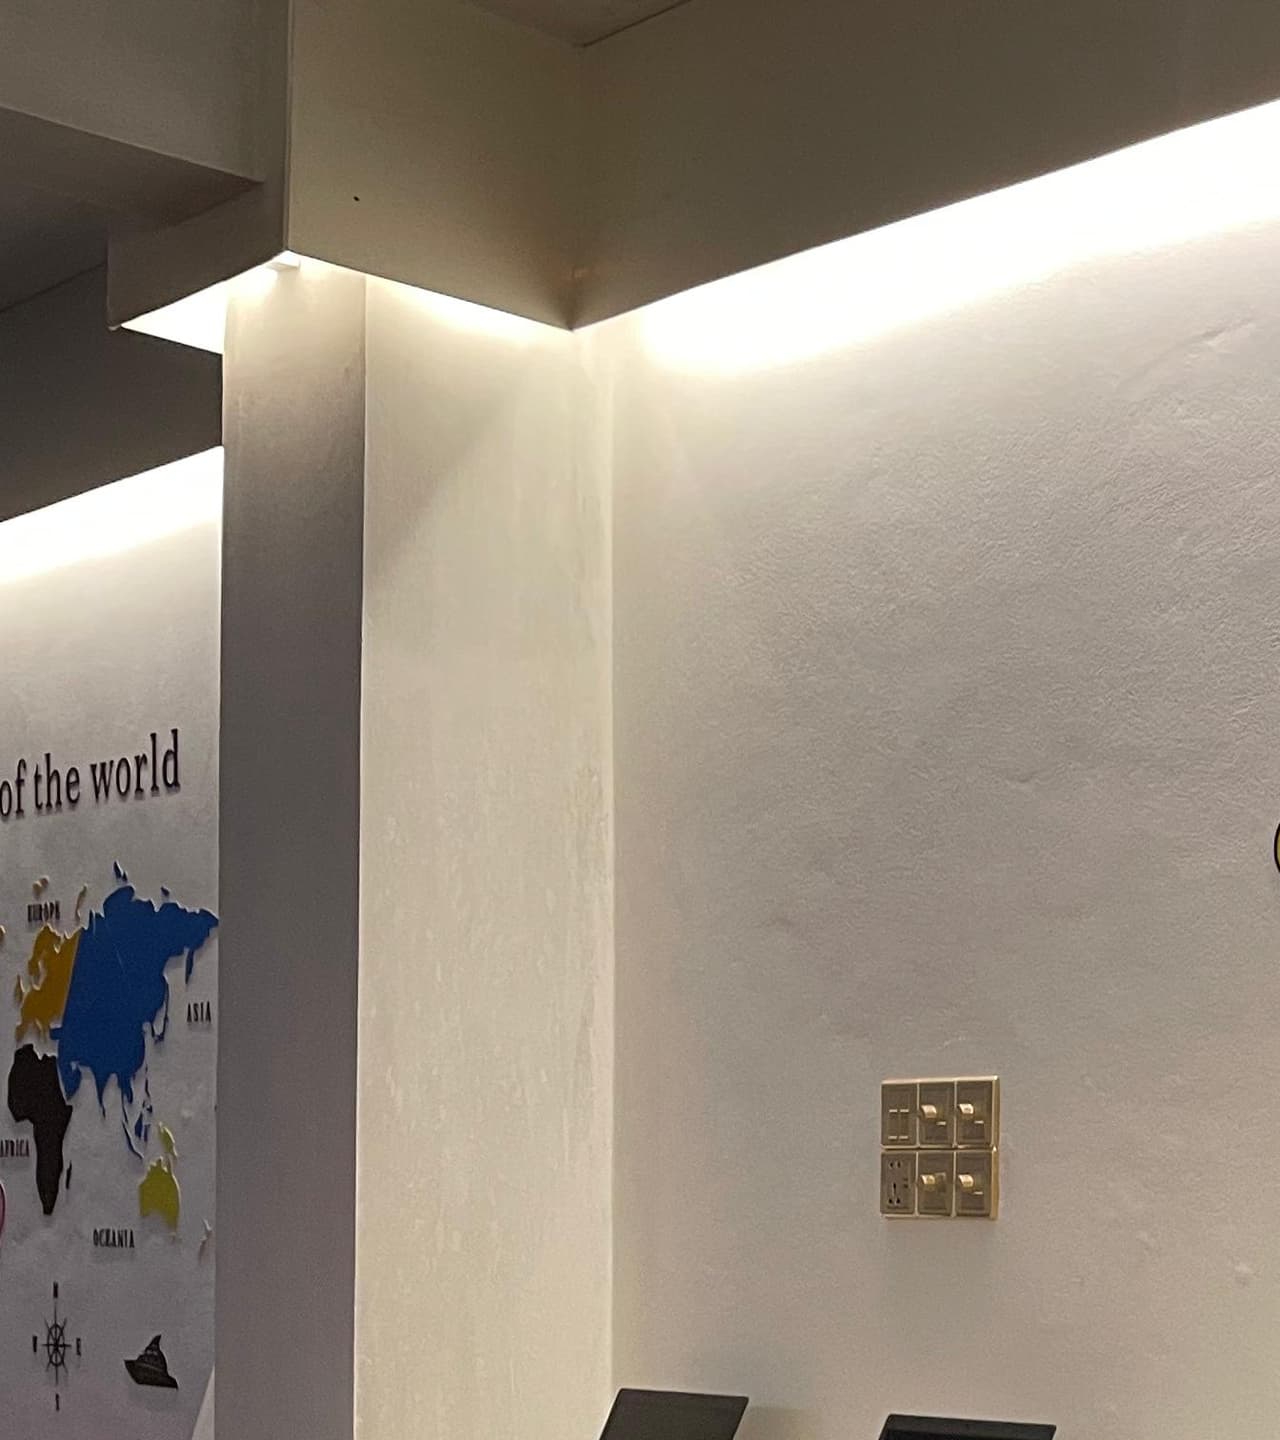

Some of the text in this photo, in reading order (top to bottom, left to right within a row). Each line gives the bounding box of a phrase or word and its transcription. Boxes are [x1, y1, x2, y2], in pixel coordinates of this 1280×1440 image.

[0, 728, 181, 818] of the world
[186, 1001, 212, 1023] ASIA
[93, 1228, 135, 1249] OCEANIA
